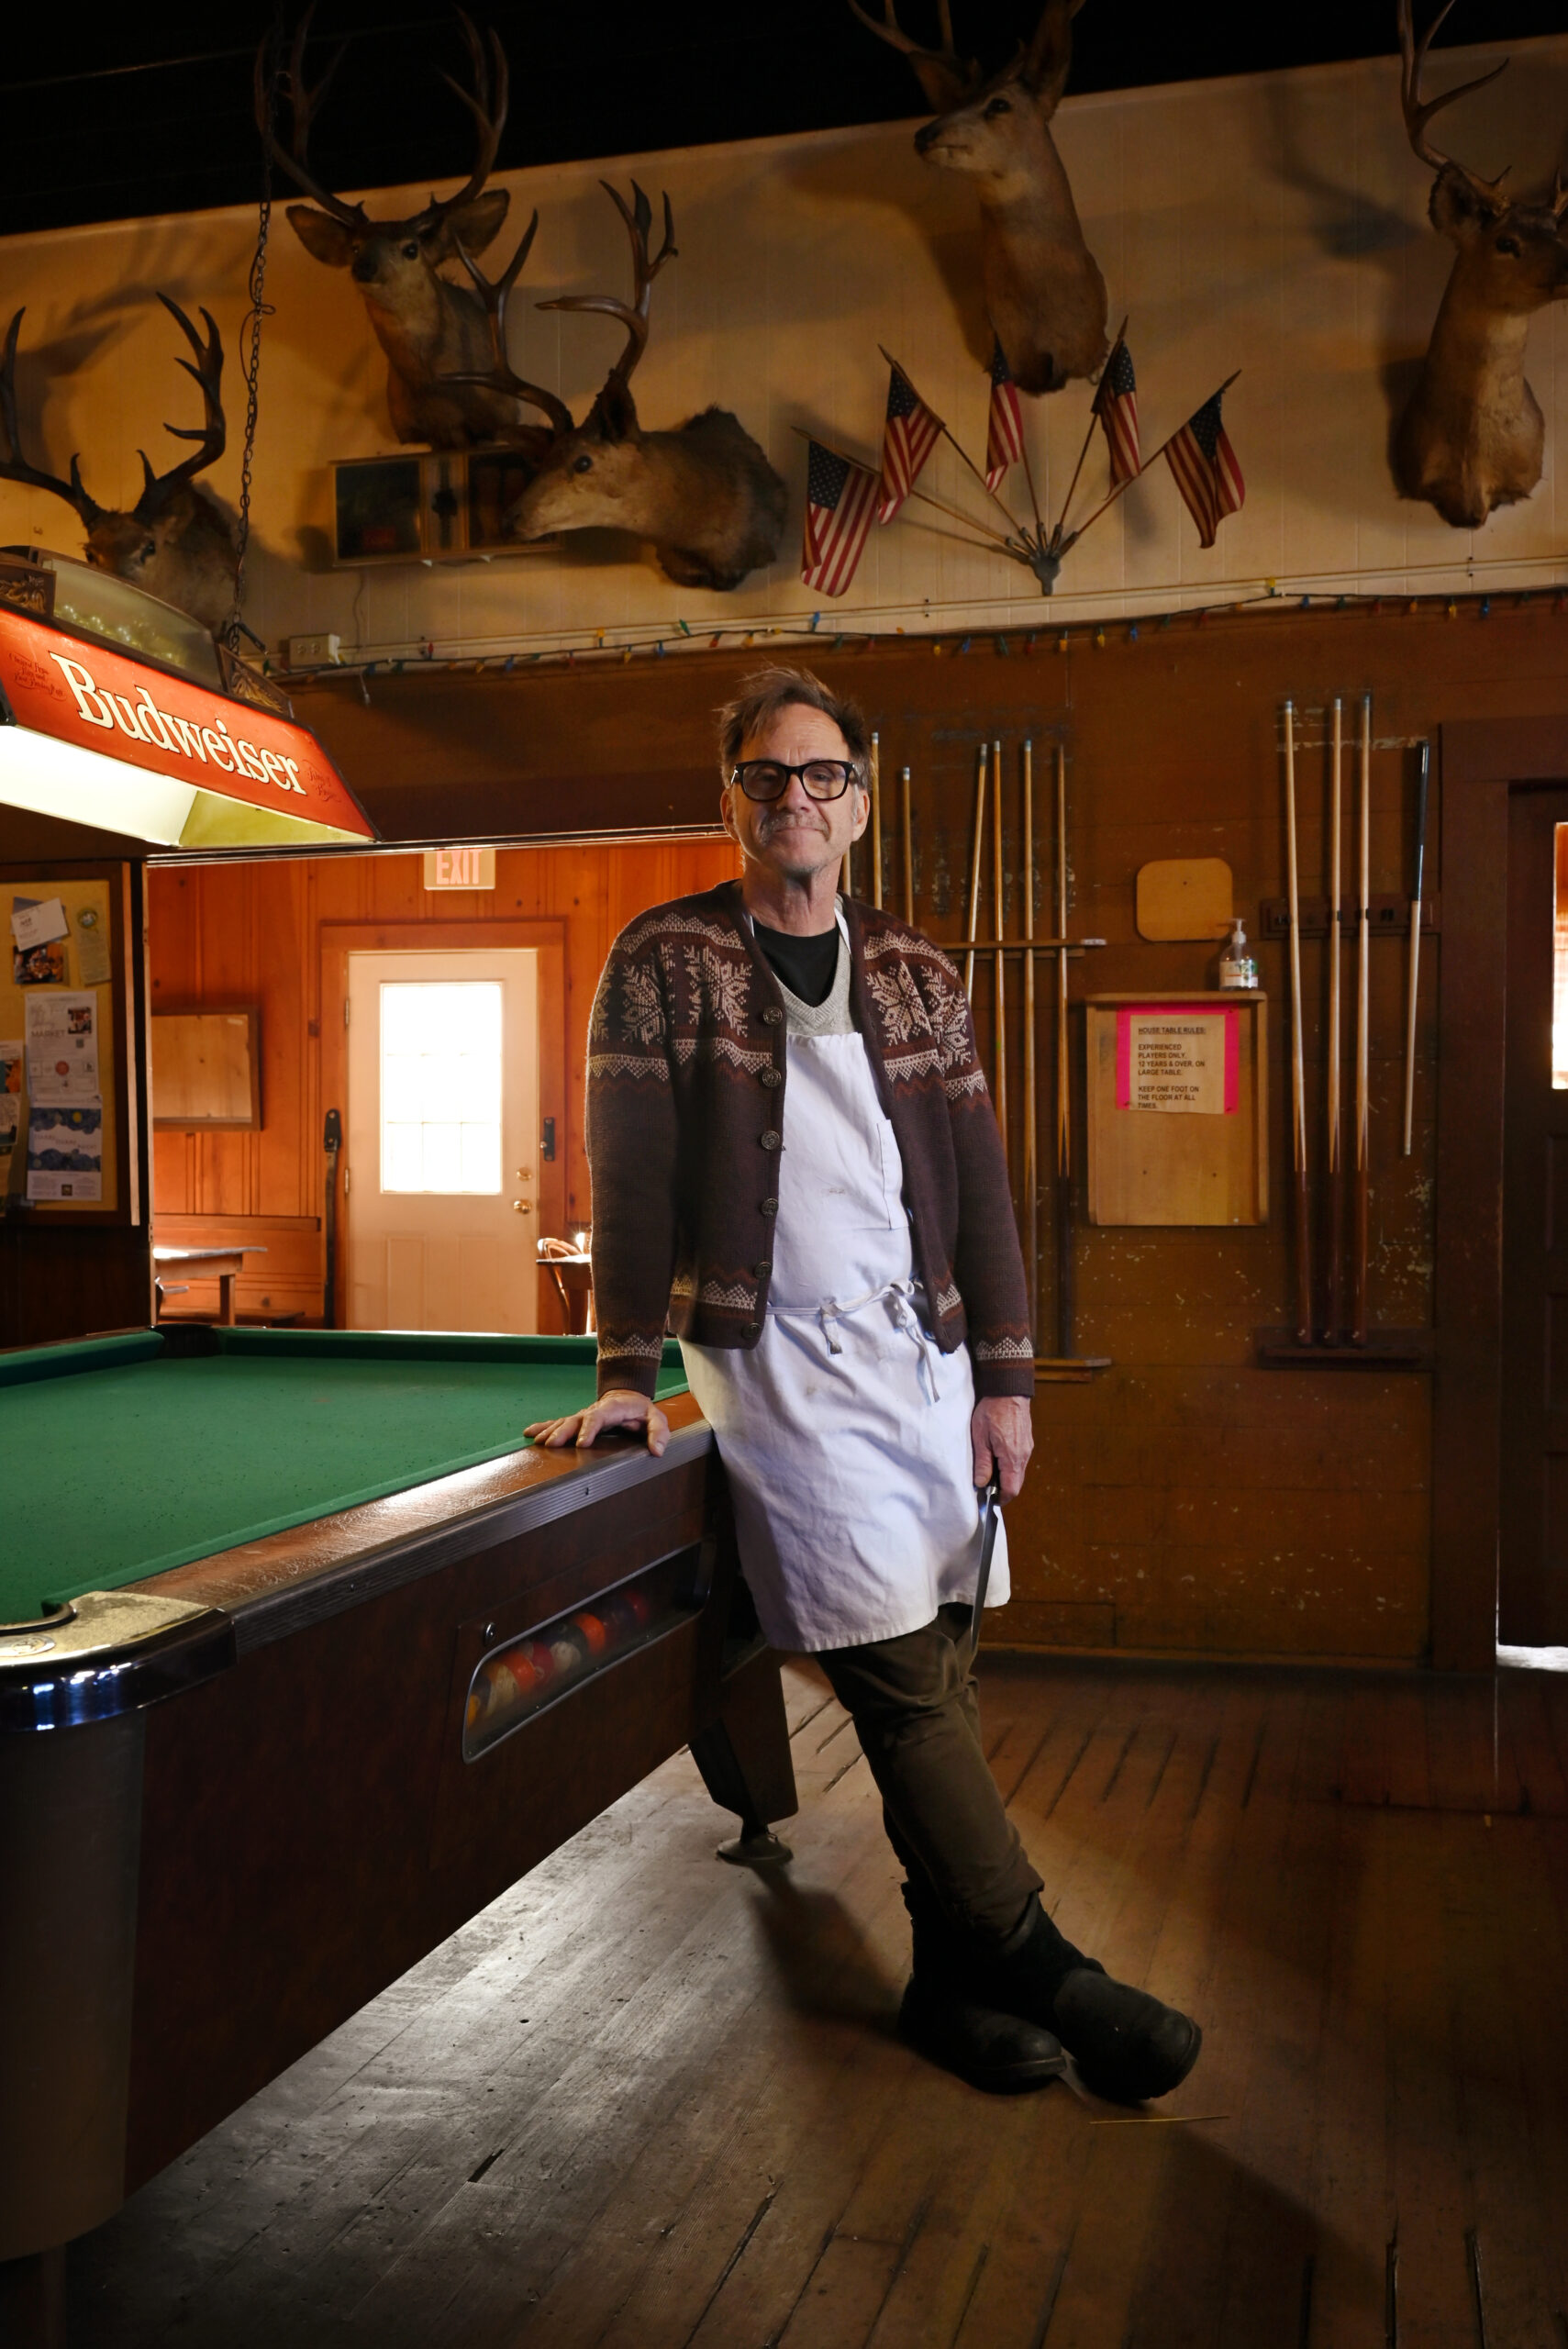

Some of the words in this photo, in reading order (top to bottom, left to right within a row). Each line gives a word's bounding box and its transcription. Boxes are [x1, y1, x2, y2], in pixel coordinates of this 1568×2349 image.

[48, 650, 307, 796] Budweiser
[436, 849, 484, 885] EXIT
[1138, 1027, 1160, 1035] HOUSE
[1162, 1027, 1182, 1035] TABLE
